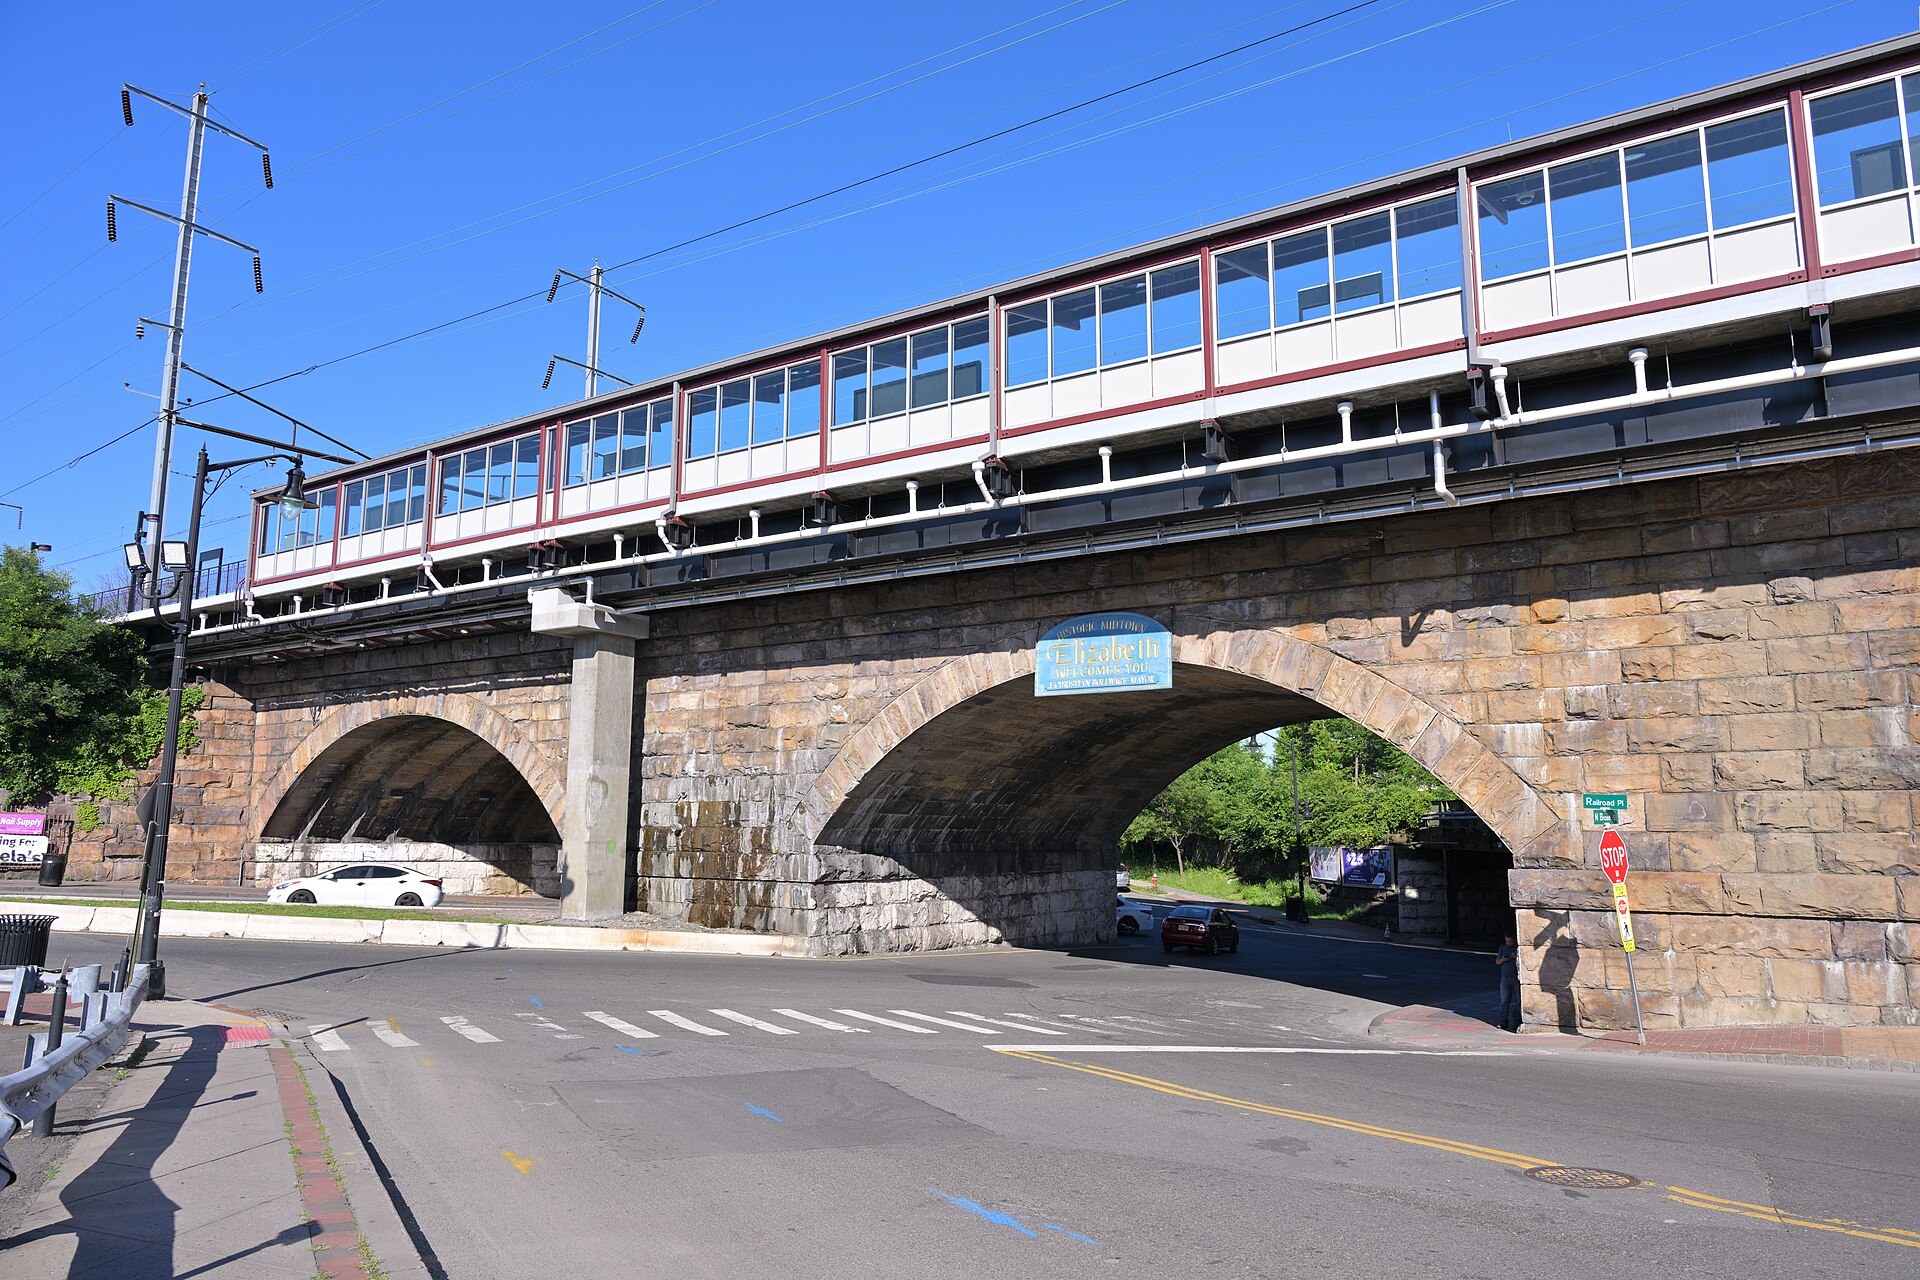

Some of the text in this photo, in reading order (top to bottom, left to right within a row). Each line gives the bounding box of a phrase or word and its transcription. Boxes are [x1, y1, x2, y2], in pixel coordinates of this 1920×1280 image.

[1056, 620, 1147, 641] HISTORIC MIDTOWN
[1047, 634, 1159, 666] Elizabeth
[1055, 662, 1149, 679] WELCOMES YOU
[1585, 797, 1615, 806] Railroad
[0, 816, 42, 828] Nail Supply
[1594, 812, 1599, 821] N
[1602, 846, 1624, 868] STOP
